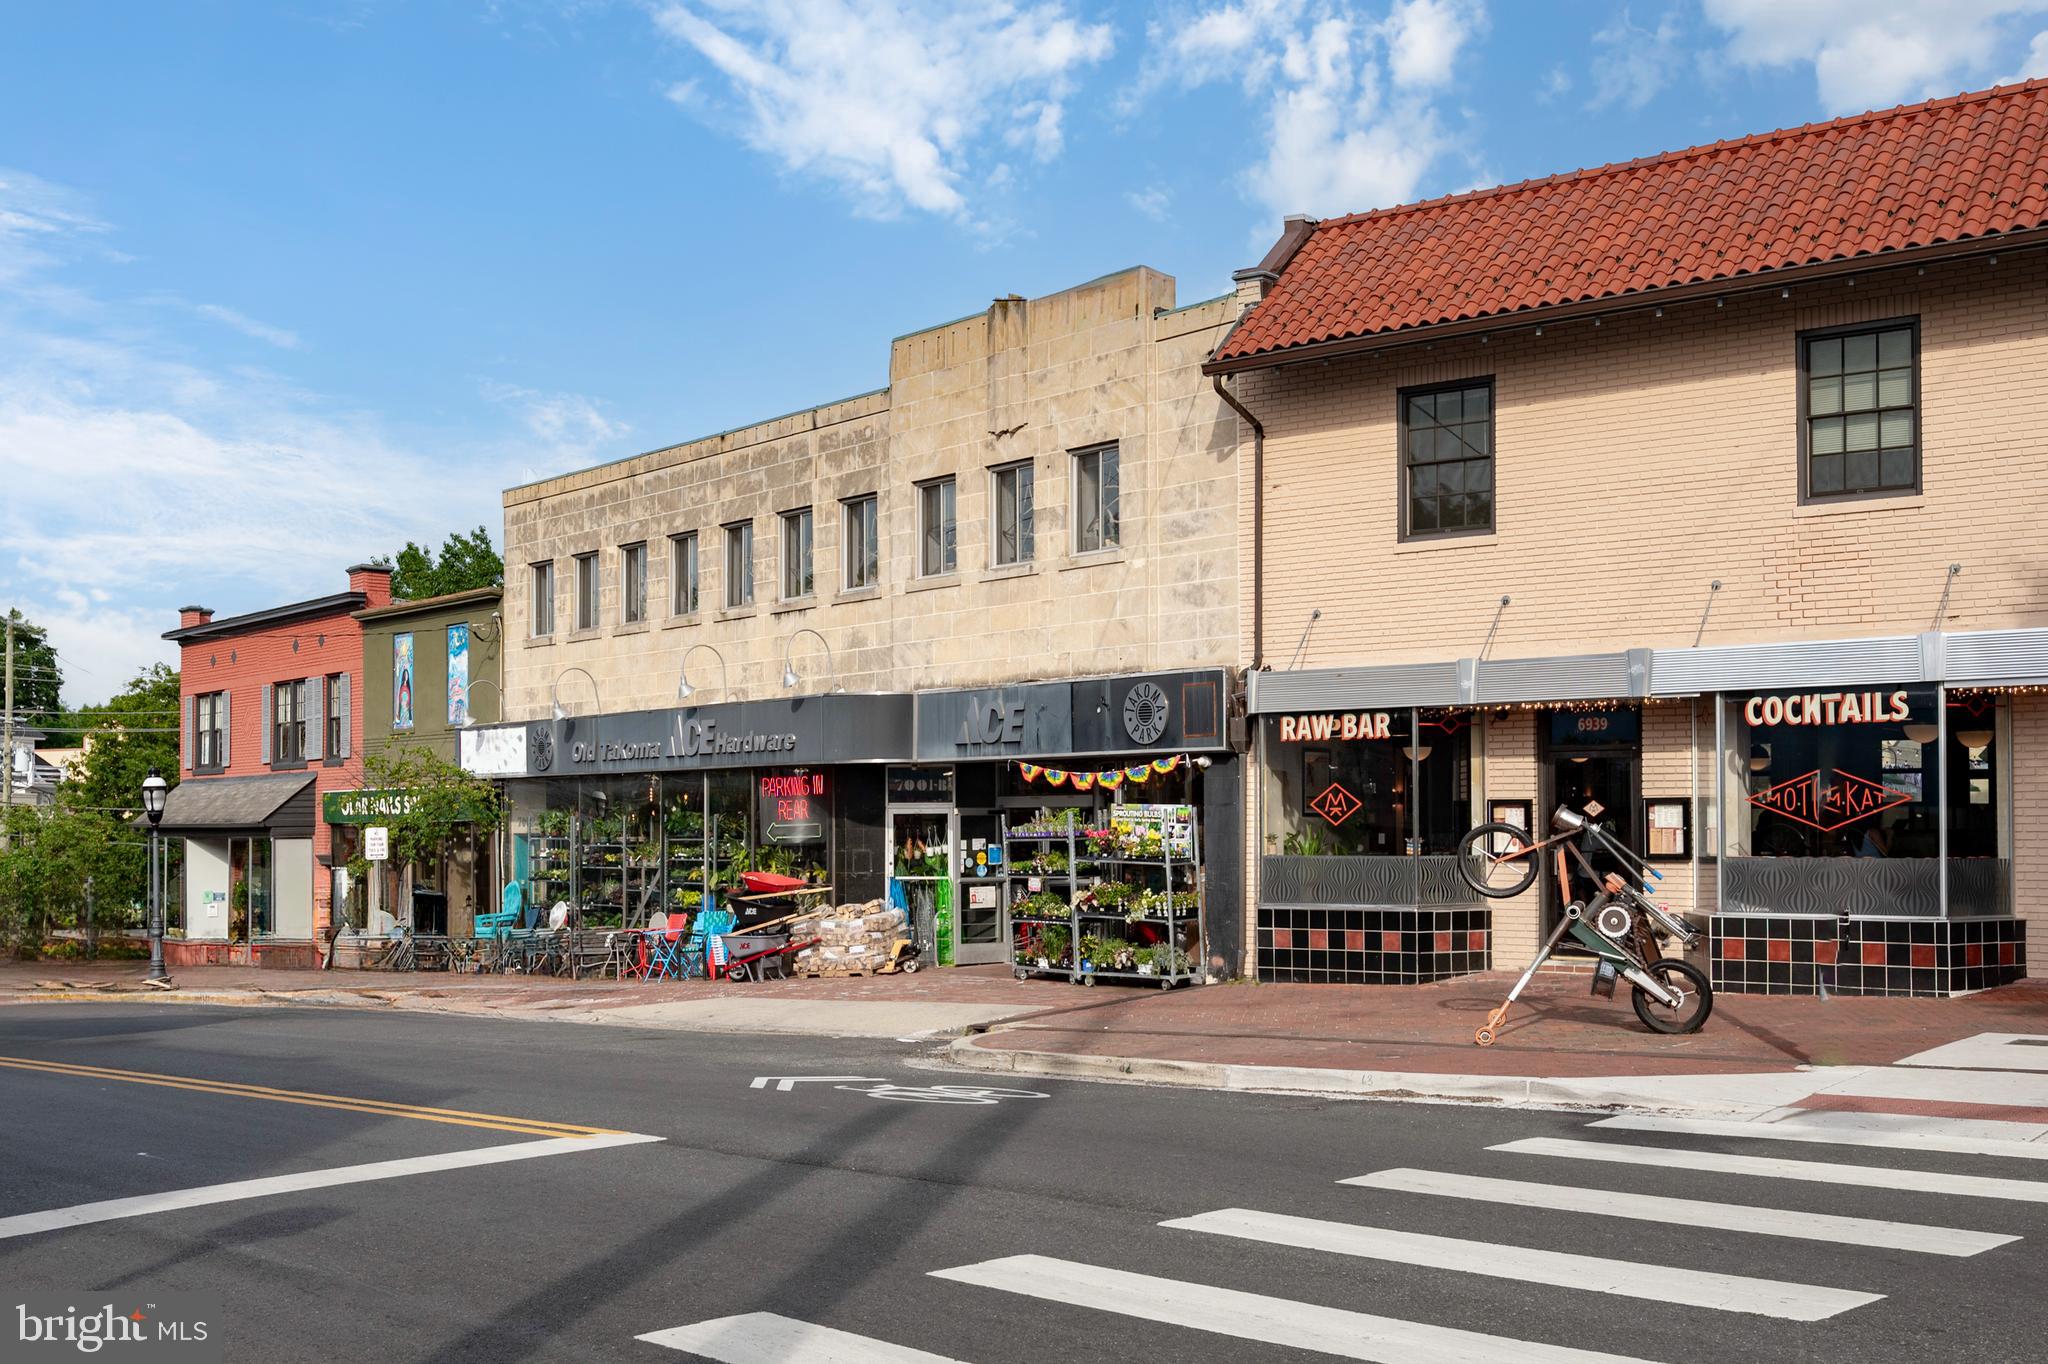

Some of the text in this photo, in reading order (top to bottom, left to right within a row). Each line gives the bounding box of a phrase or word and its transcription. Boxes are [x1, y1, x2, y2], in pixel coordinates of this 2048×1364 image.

[1125, 684, 1166, 714] TAKOMA
[1745, 691, 1910, 727] COCKTAILS
[955, 696, 1025, 745] ACE
[1131, 722, 1161, 742] PARK
[1280, 712, 1391, 742] RAW BAR
[1577, 717, 1608, 732] 6939
[571, 714, 797, 763] Old Takoma ACE Hardware
[761, 774, 824, 798] PARKING IN
[778, 799, 809, 821] REAR
[744, 907, 757, 915] ACE
[739, 942, 751, 950] ACE
